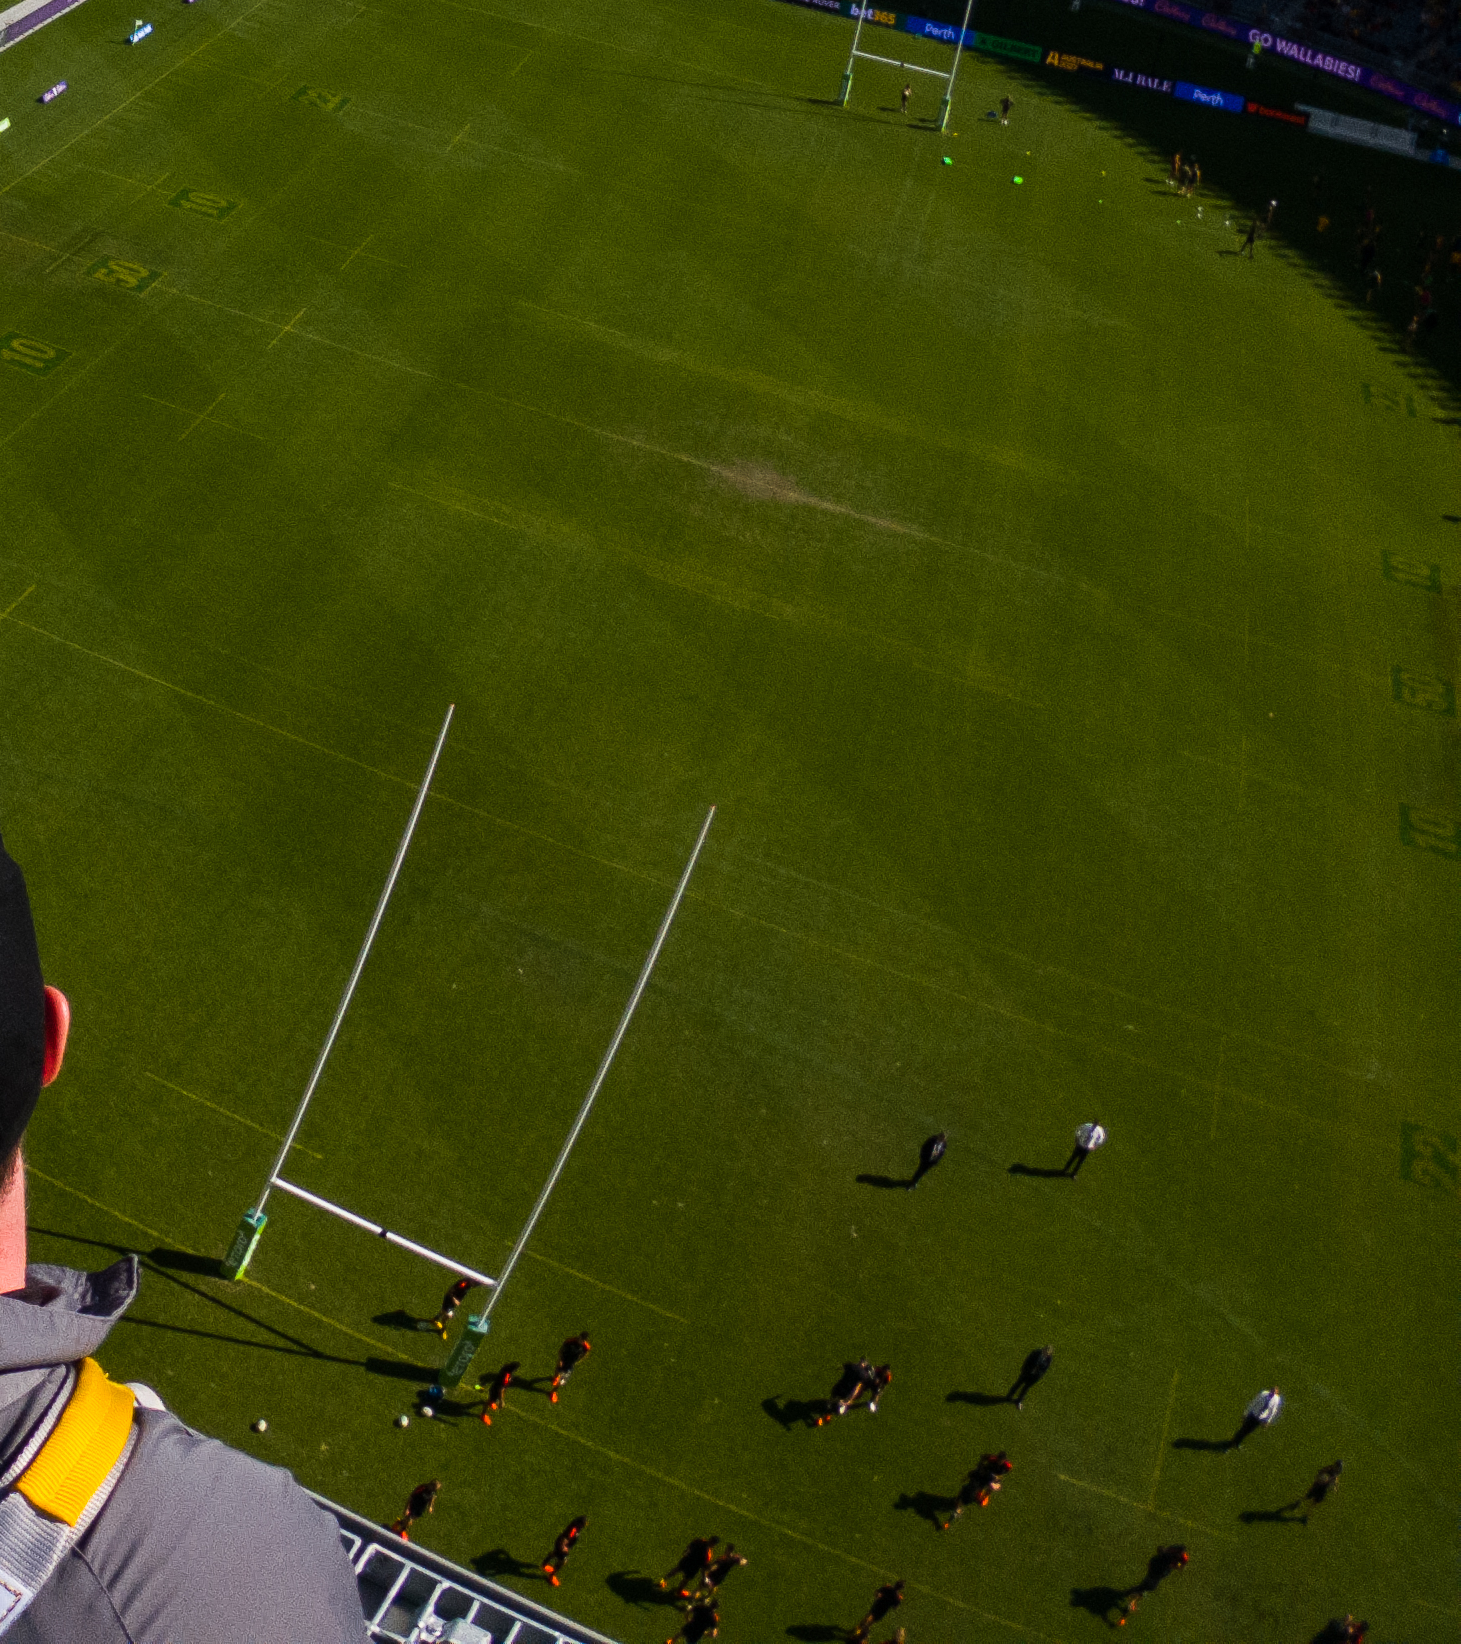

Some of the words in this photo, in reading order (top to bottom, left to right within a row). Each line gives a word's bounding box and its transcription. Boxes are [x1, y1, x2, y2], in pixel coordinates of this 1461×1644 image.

[850, 2, 897, 25] bet365
[924, 22, 956, 40] Perth
[1247, 27, 1273, 48] GO
[1275, 36, 1362, 83] WALLABIES!
[1192, 88, 1224, 106] Perth
